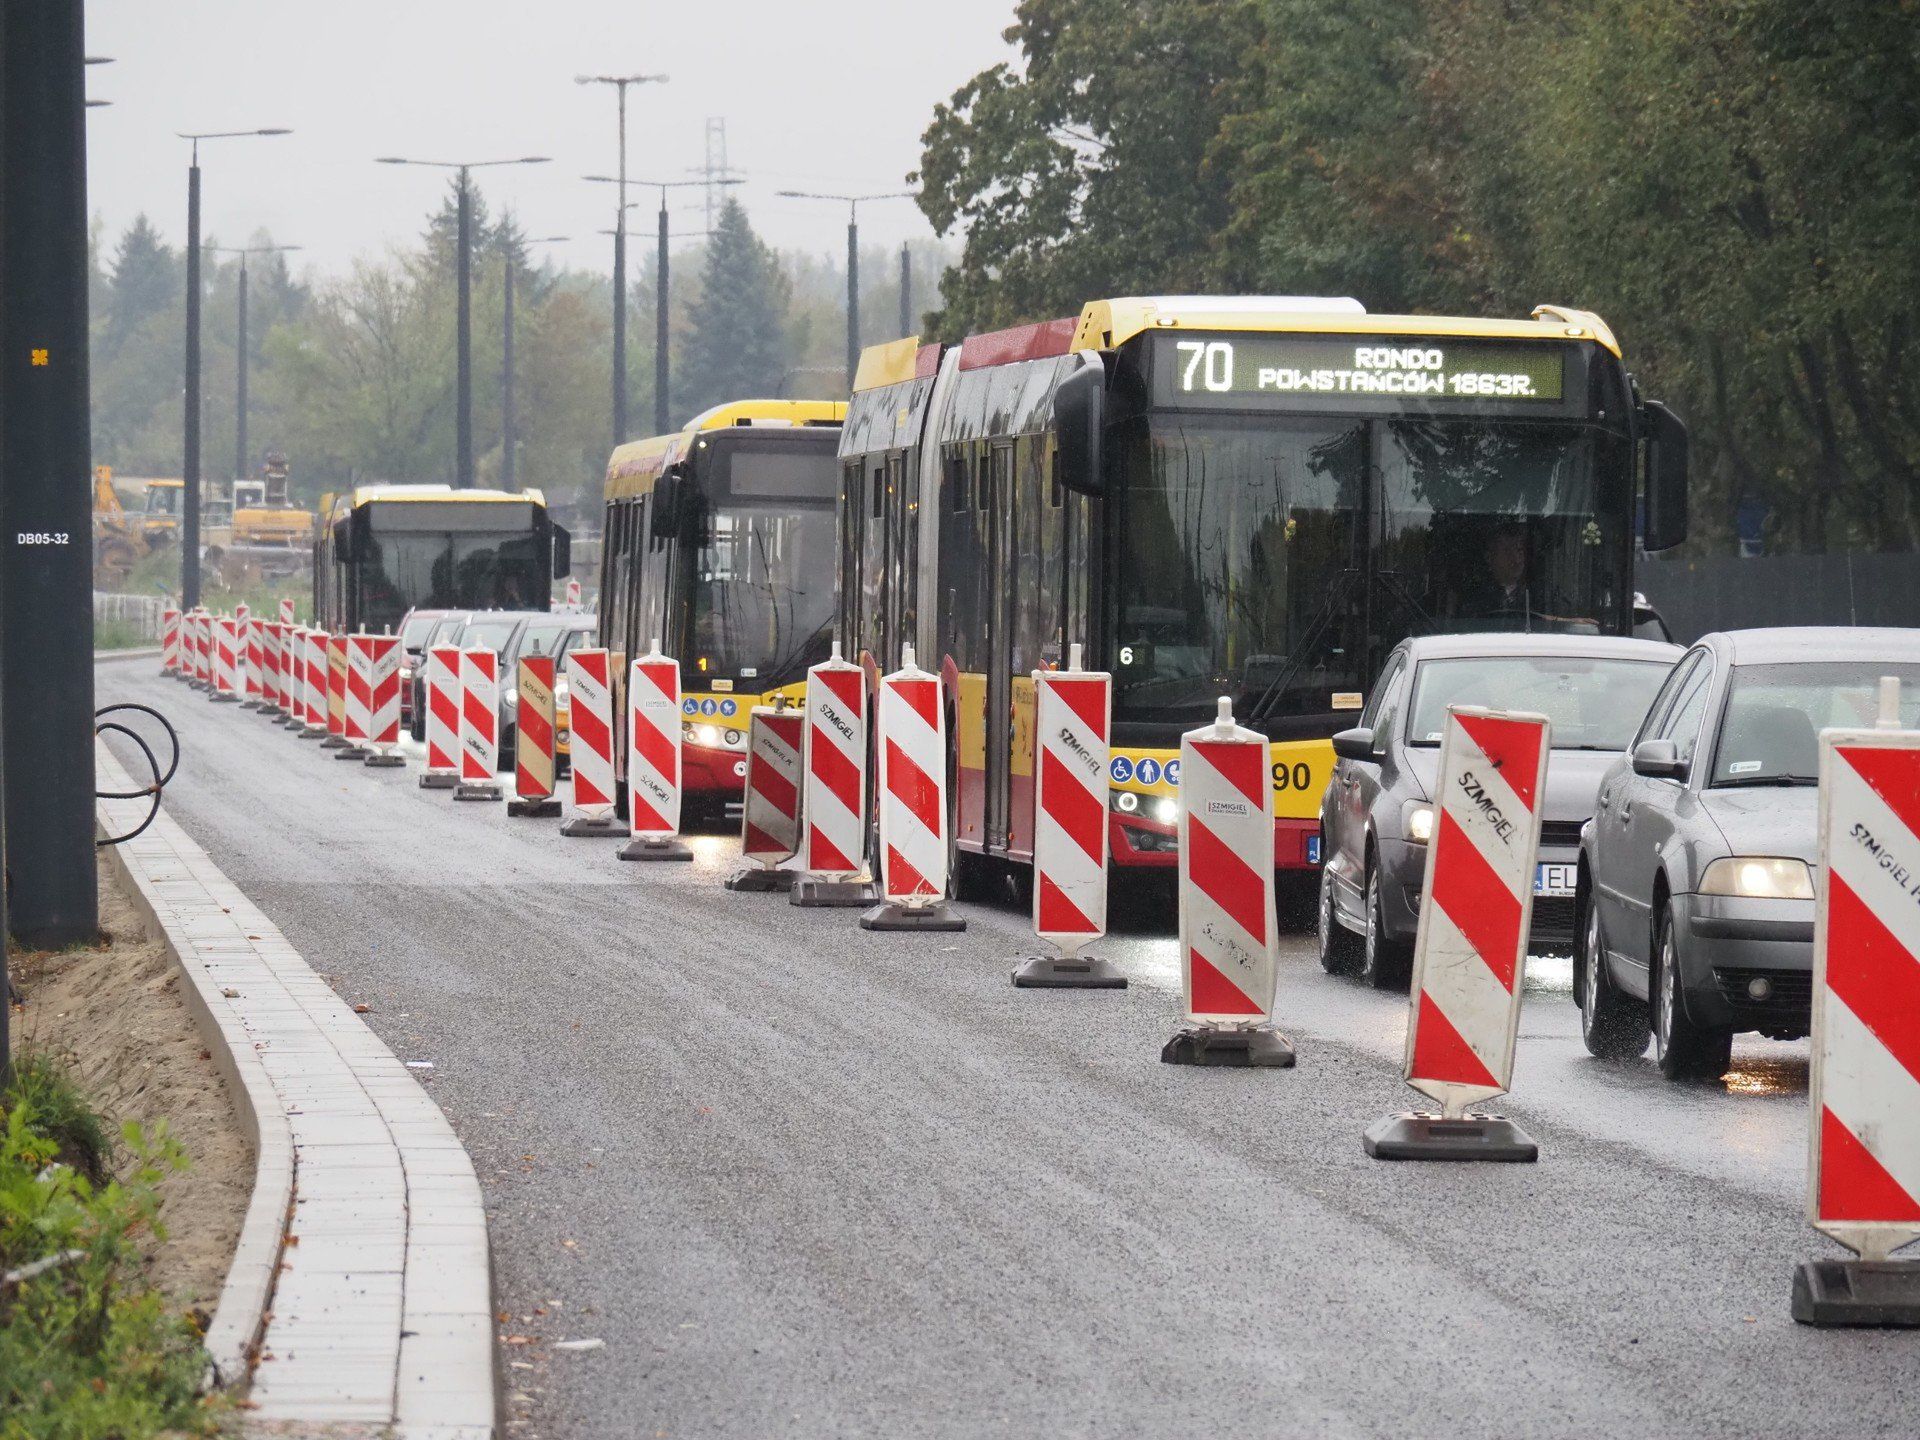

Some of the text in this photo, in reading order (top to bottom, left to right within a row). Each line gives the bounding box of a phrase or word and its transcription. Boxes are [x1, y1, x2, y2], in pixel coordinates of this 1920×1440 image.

[1176, 341, 1234, 392] 70
[1355, 347, 1444, 370] RONDO
[1258, 367, 1536, 396] POWSTAŃCÓW 1863R.
[17, 533, 69, 545] DB05-32
[1120, 646, 1133, 665] 6
[820, 703, 854, 741] SZMIGIEL
[1059, 727, 1101, 776] SZMIGIEL
[1212, 802, 1247, 811] SZMIGIEL
[1458, 771, 1519, 845] SZMIGIEL
[1850, 823, 1910, 888] SZMIGIEL
